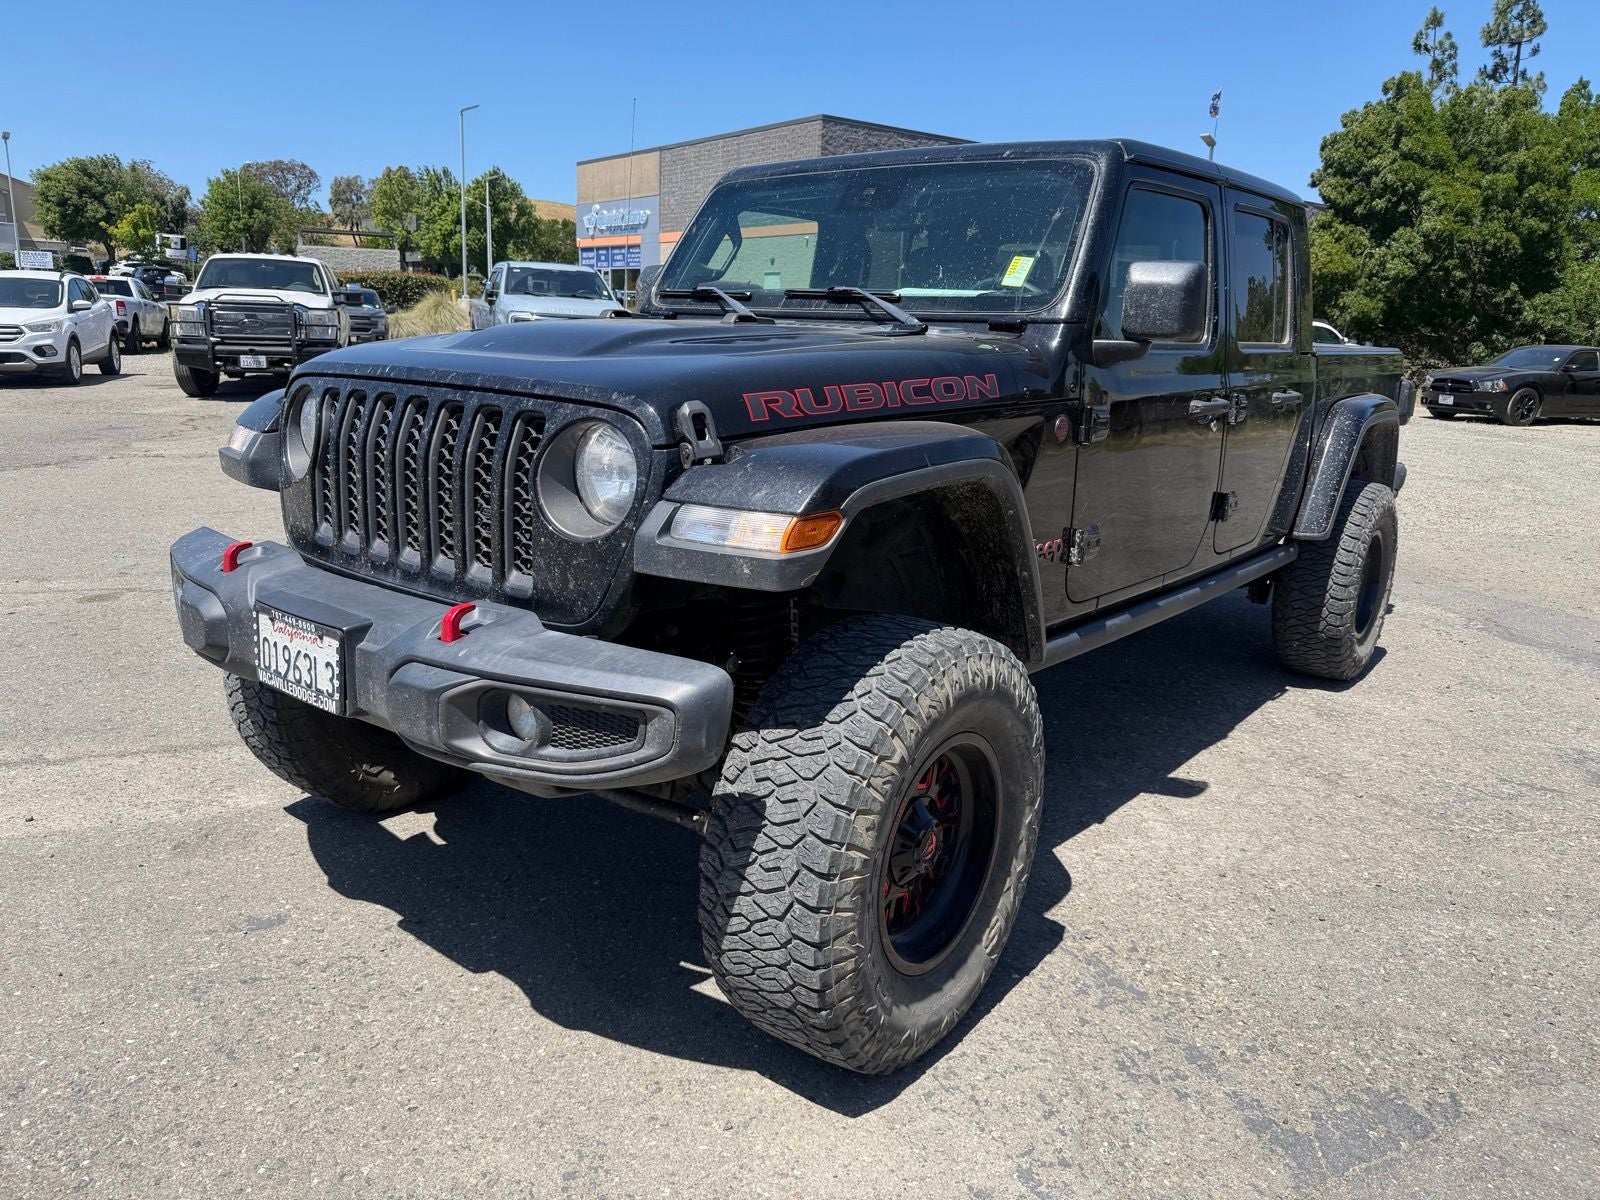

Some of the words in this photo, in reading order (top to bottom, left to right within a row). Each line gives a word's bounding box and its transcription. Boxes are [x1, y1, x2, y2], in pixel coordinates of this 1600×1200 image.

[742, 373, 1000, 422] RUBICON
[1032, 538, 1064, 563] eep
[271, 610, 316, 633] 707-449-8900
[262, 636, 336, 698] 01963L3
[257, 669, 337, 715] VACAVILLEDODGE.COM
